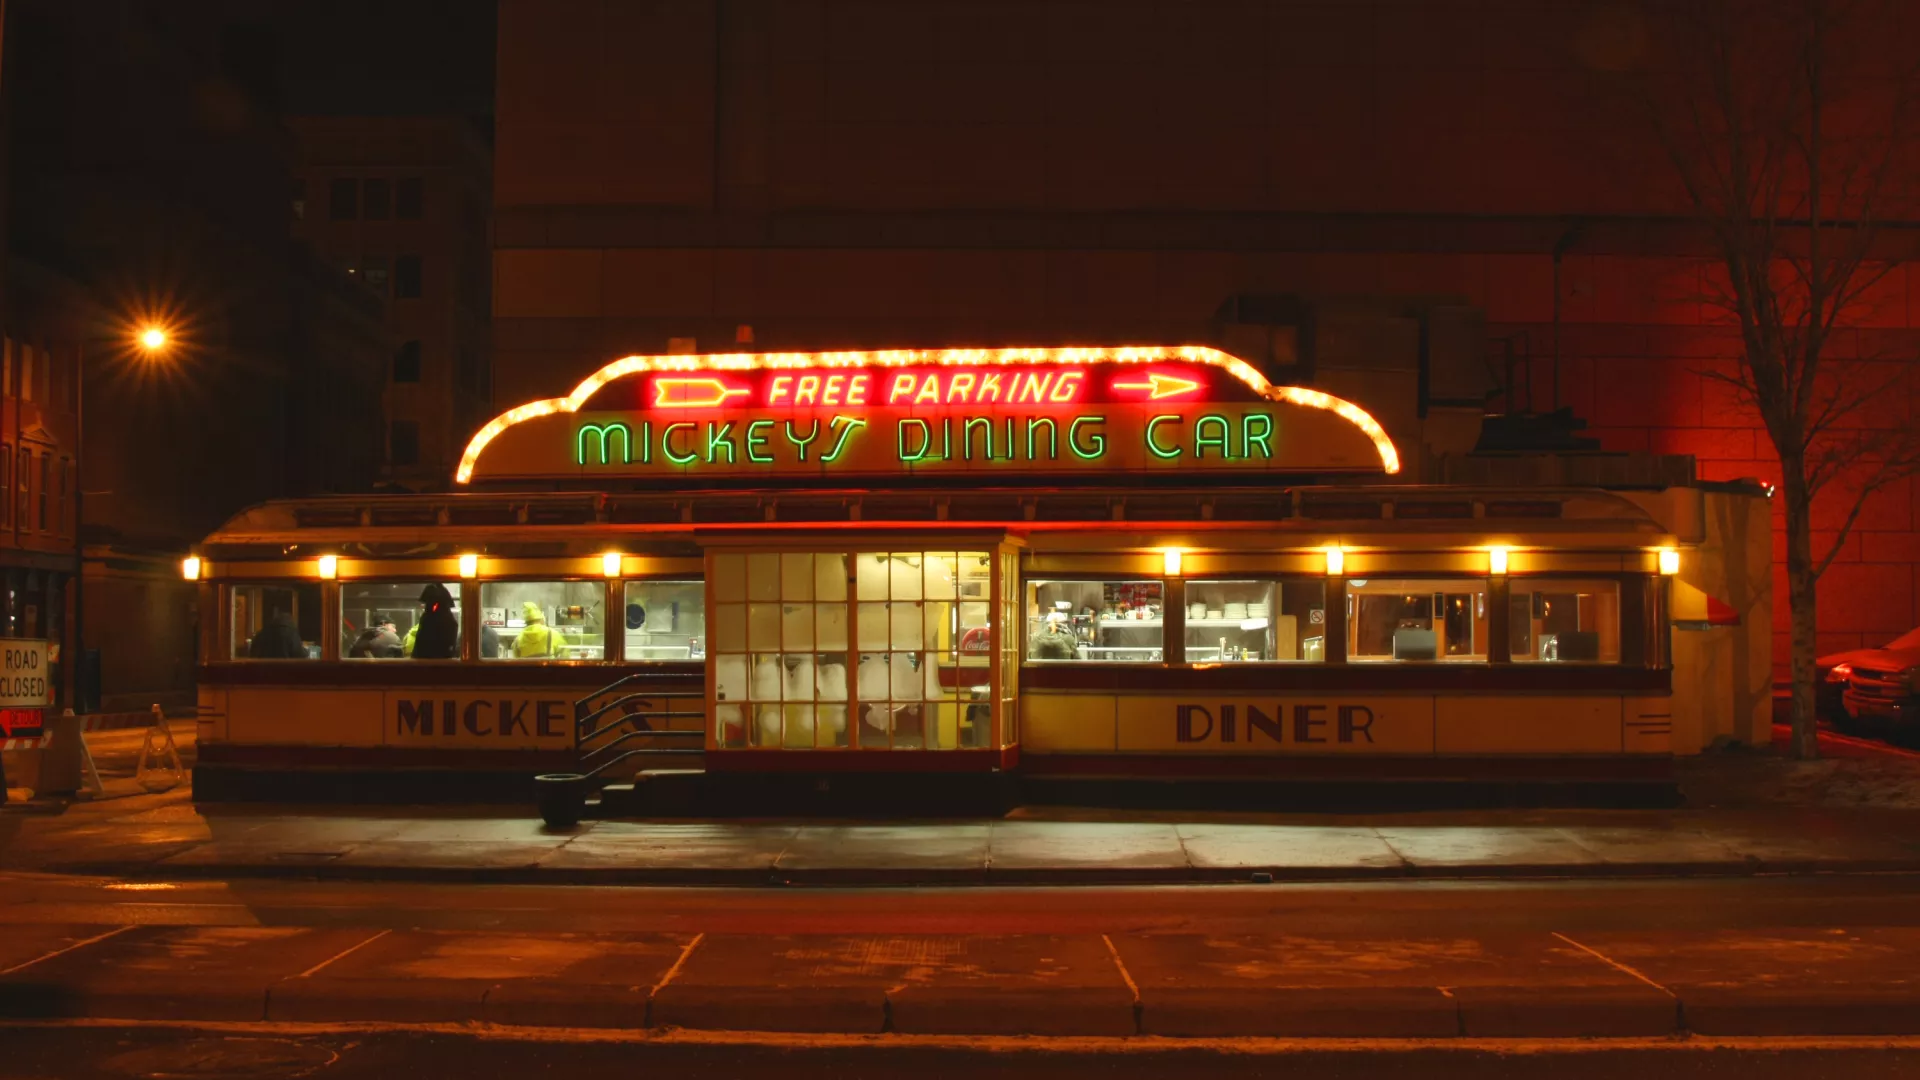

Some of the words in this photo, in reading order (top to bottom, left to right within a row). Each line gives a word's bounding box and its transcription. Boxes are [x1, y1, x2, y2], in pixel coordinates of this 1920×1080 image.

[768, 374, 868, 405] FREE
[889, 372, 1084, 404] PARKING
[898, 414, 1108, 461] DINING
[1145, 412, 1274, 461] CAR
[6, 649, 38, 669] ROAD
[0, 677, 45, 697] CLOSED
[1176, 704, 1377, 744] DINER
